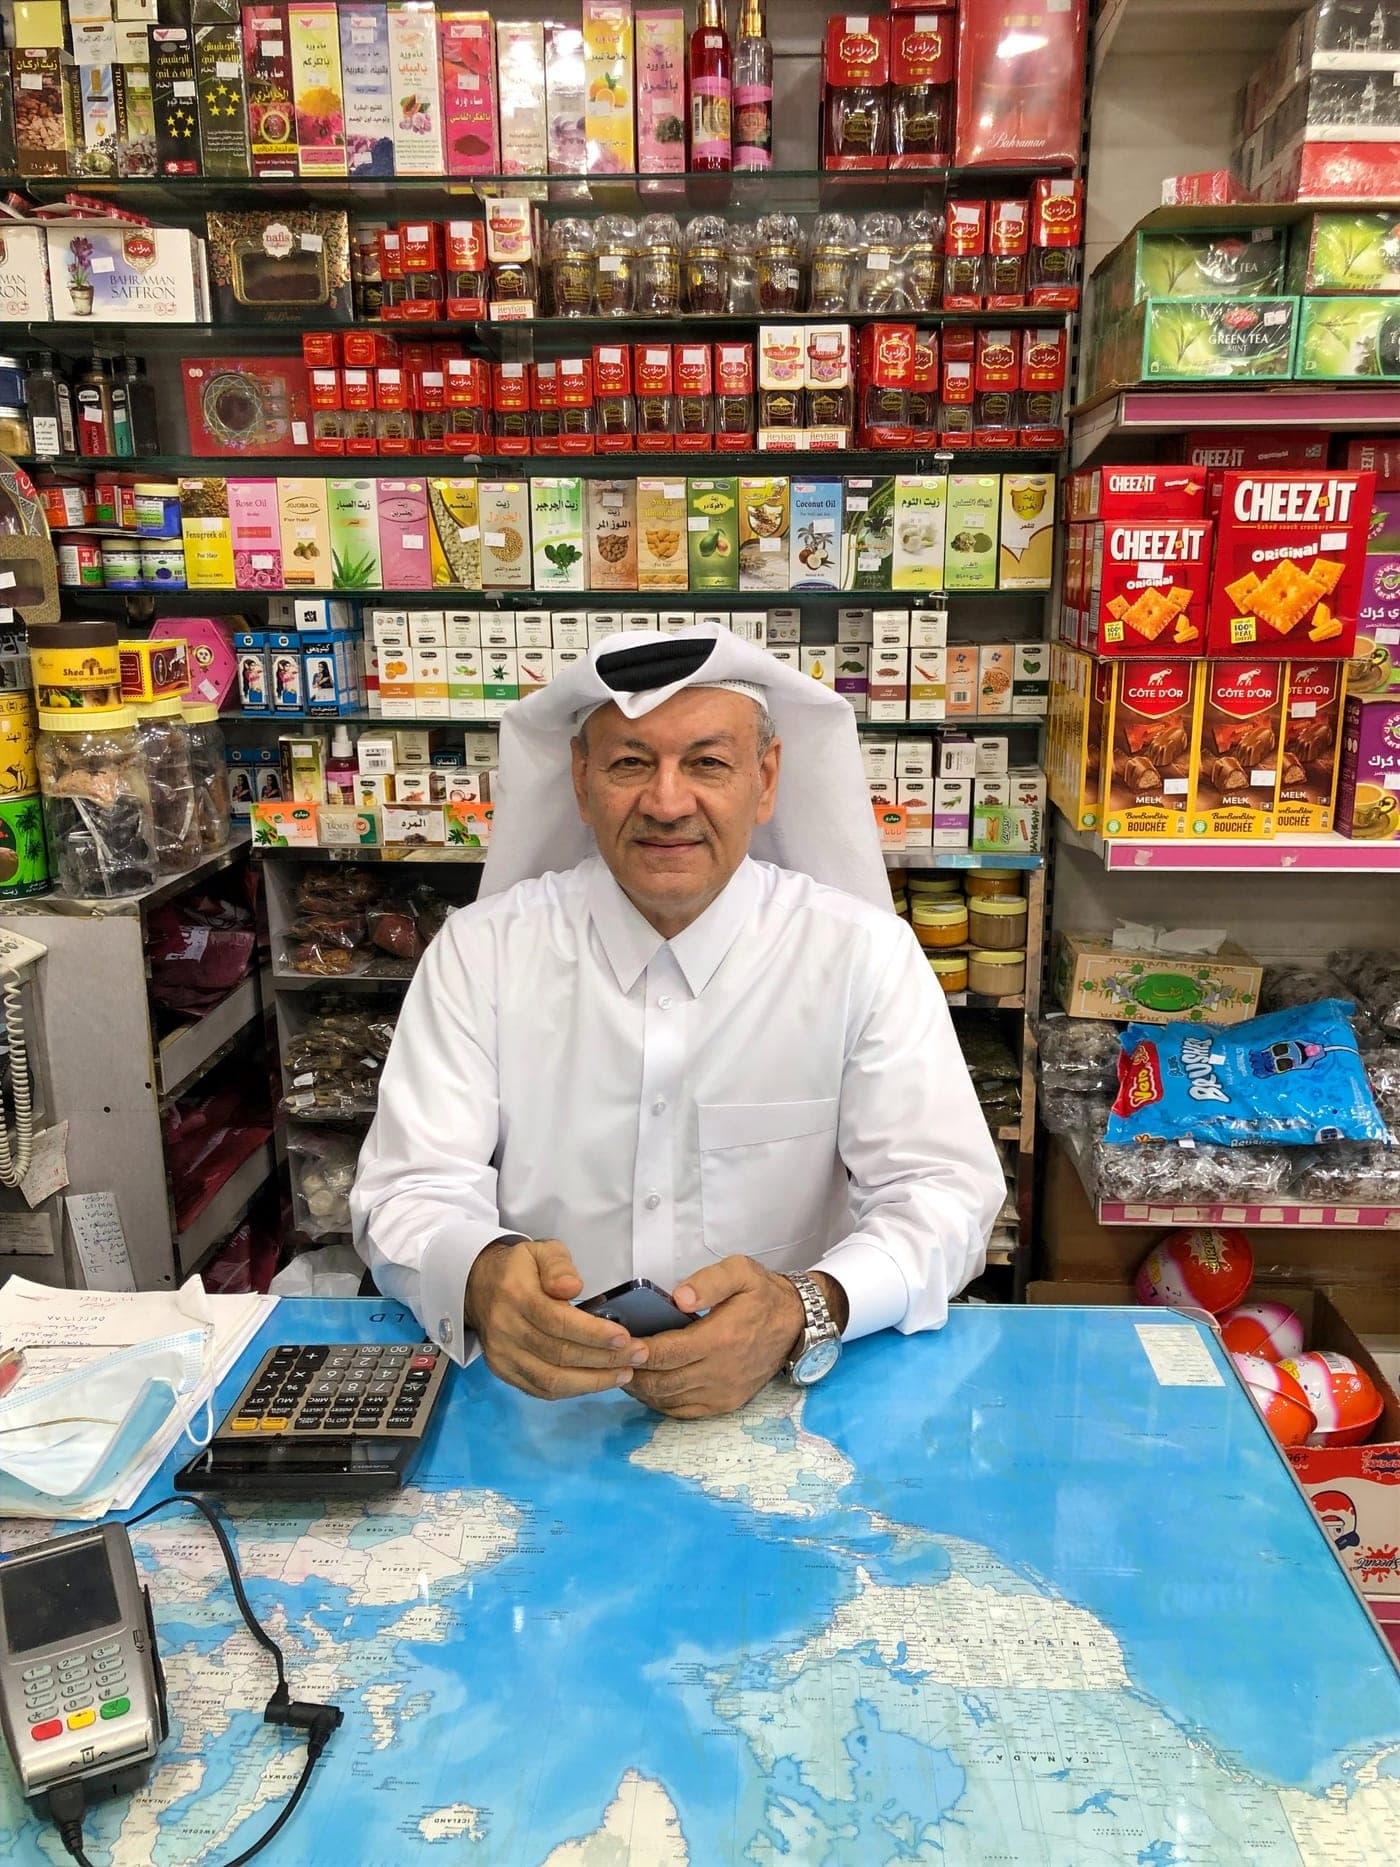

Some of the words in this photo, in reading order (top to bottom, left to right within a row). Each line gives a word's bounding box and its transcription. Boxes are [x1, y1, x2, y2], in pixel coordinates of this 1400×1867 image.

[117, 90, 126, 133] CASTOR
[265, 232, 291, 243] nafis
[1240, 263, 1258, 272] TEA
[110, 275, 175, 285] BAHRAMAN
[111, 287, 175, 299] SAFFRON
[497, 304, 526, 314] Reyhan
[1208, 334, 1246, 345] GREEN
[1249, 333, 1269, 344] TEA
[766, 432, 796, 441] Reyhan
[810, 431, 840, 441] Reyhan
[235, 500, 253, 508] Rose
[255, 500, 267, 508] Oil
[336, 500, 356, 510] الصبار
[357, 500, 371, 510] زيت
[535, 501, 564, 511] الجرجير
[564, 501, 579, 511] زيت
[795, 499, 824, 508] Coconut
[825, 499, 836, 508] Oil
[901, 498, 922, 509] الثوم
[923, 498, 940, 509] زيت
[608, 509, 620, 517] زيت
[610, 521, 631, 531] اللوز
[186, 531, 217, 541] Fenugreek
[219, 530, 228, 539] oil
[1360, 607, 1384, 620] كرك
[63, 668, 84, 677] Shea
[98, 667, 117, 677] Butter
[1128, 687, 1155, 698] CÔTE
[1158, 687, 1184, 698] D'OR
[1217, 687, 1244, 698] CÔTE
[1247, 687, 1272, 698] D'OR
[1304, 685, 1330, 696] D'OR
[1368, 755, 1394, 767] كرك
[1281, 791, 1307, 799] MELK
[1222, 797, 1249, 805] MELK
[401, 819, 426, 829] المرد
[1278, 814, 1311, 827] OUCHÉE
[1128, 819, 1167, 832] BOUCHÉE
[1214, 819, 1253, 833] BOUCHÉE
[327, 1370, 338, 1378] 6
[354, 1370, 364, 1378] 5
[382, 1370, 393, 1378] 4
[319, 1383, 330, 1391] 9
[347, 1383, 358, 1391] 8
[375, 1383, 386, 1391] 7
[921, 1637, 998, 1645] STATES
[1017, 1639, 1096, 1647] UNITED
[97, 1648, 104, 1656] 3
[62, 1659, 69, 1668] 2
[99, 1660, 106, 1669] 6
[28, 1668, 35, 1677] 1
[64, 1671, 71, 1680] 5
[101, 1674, 108, 1682] 9
[30, 1682, 37, 1691] 4
[66, 1684, 74, 1693] 8
[103, 1688, 111, 1696] #
[31, 1696, 39, 1705] 7
[69, 1699, 77, 1708] 0
[996, 1754, 1090, 1765] CANADA
